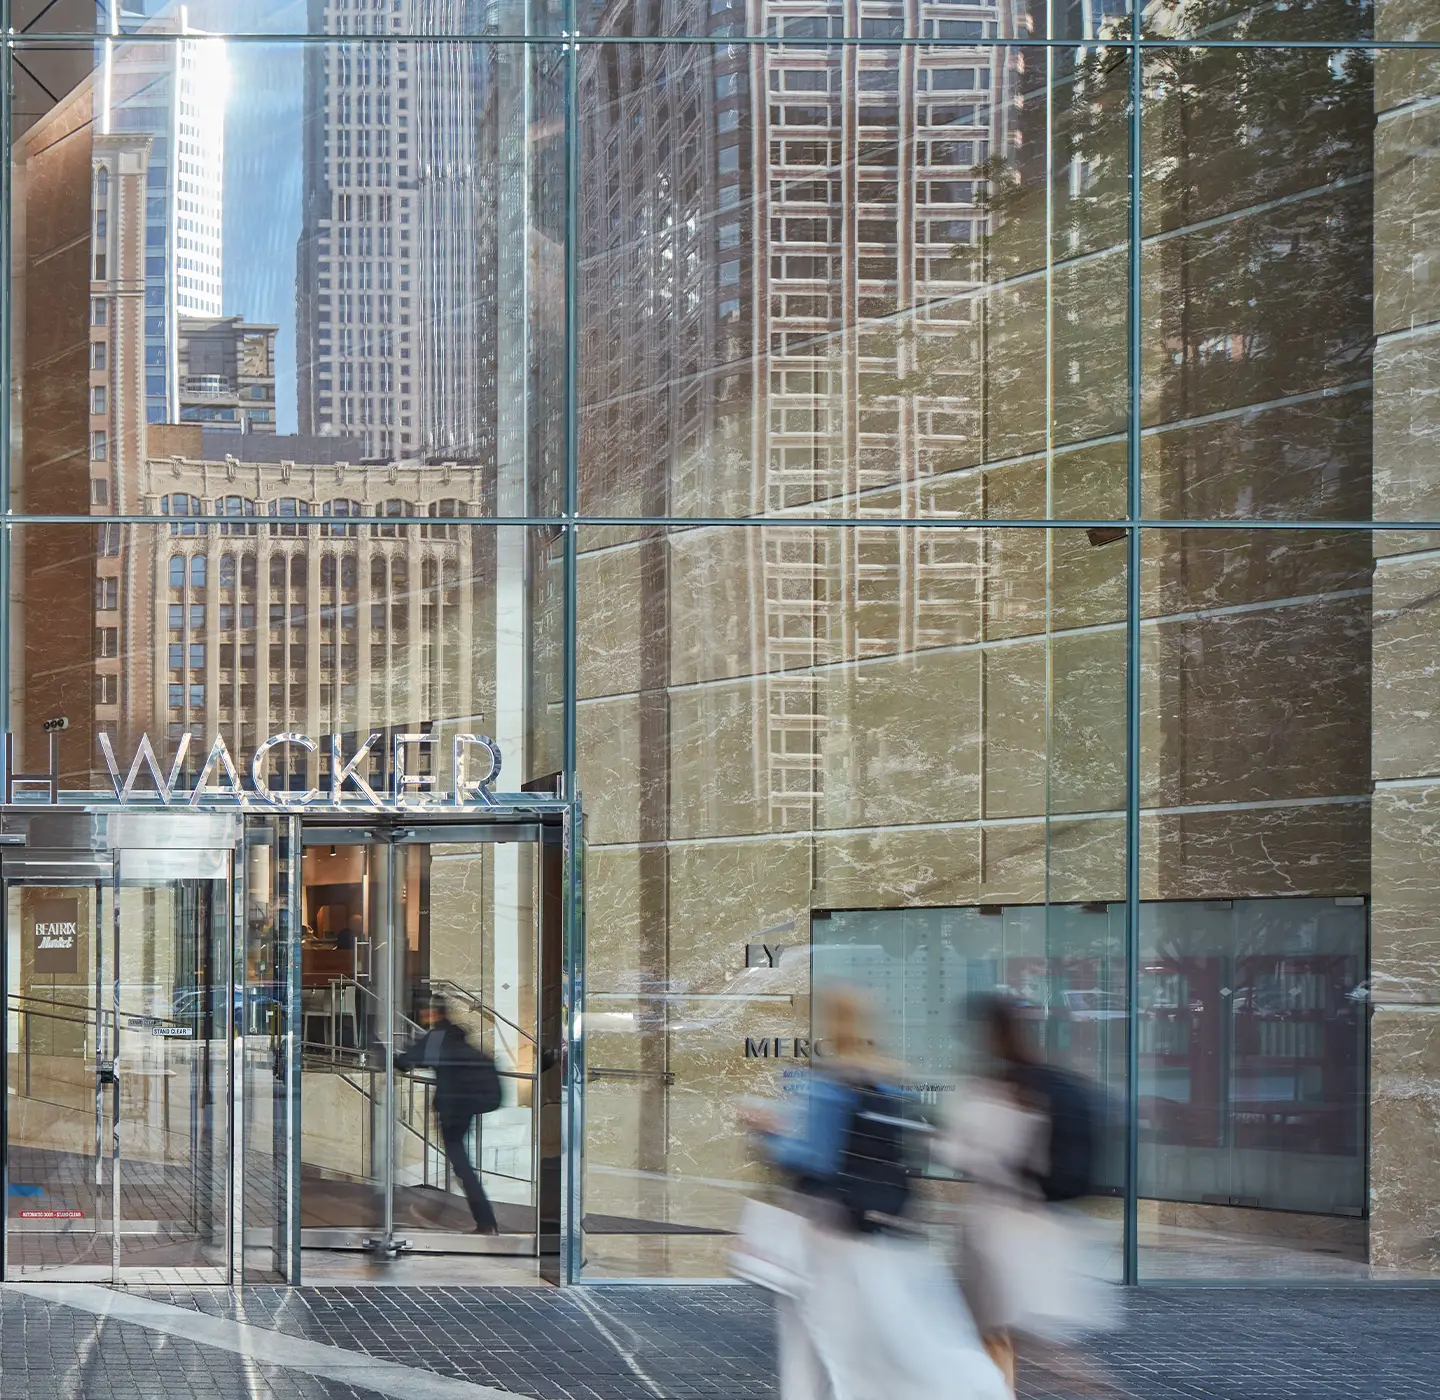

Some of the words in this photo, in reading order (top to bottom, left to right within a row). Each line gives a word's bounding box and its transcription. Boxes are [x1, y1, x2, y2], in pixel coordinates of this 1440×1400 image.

[98, 731, 503, 807] WACKER
[35, 922, 76, 935] BEATRIX
[37, 936, 74, 949] Market
[745, 1037, 874, 1058] MERC
